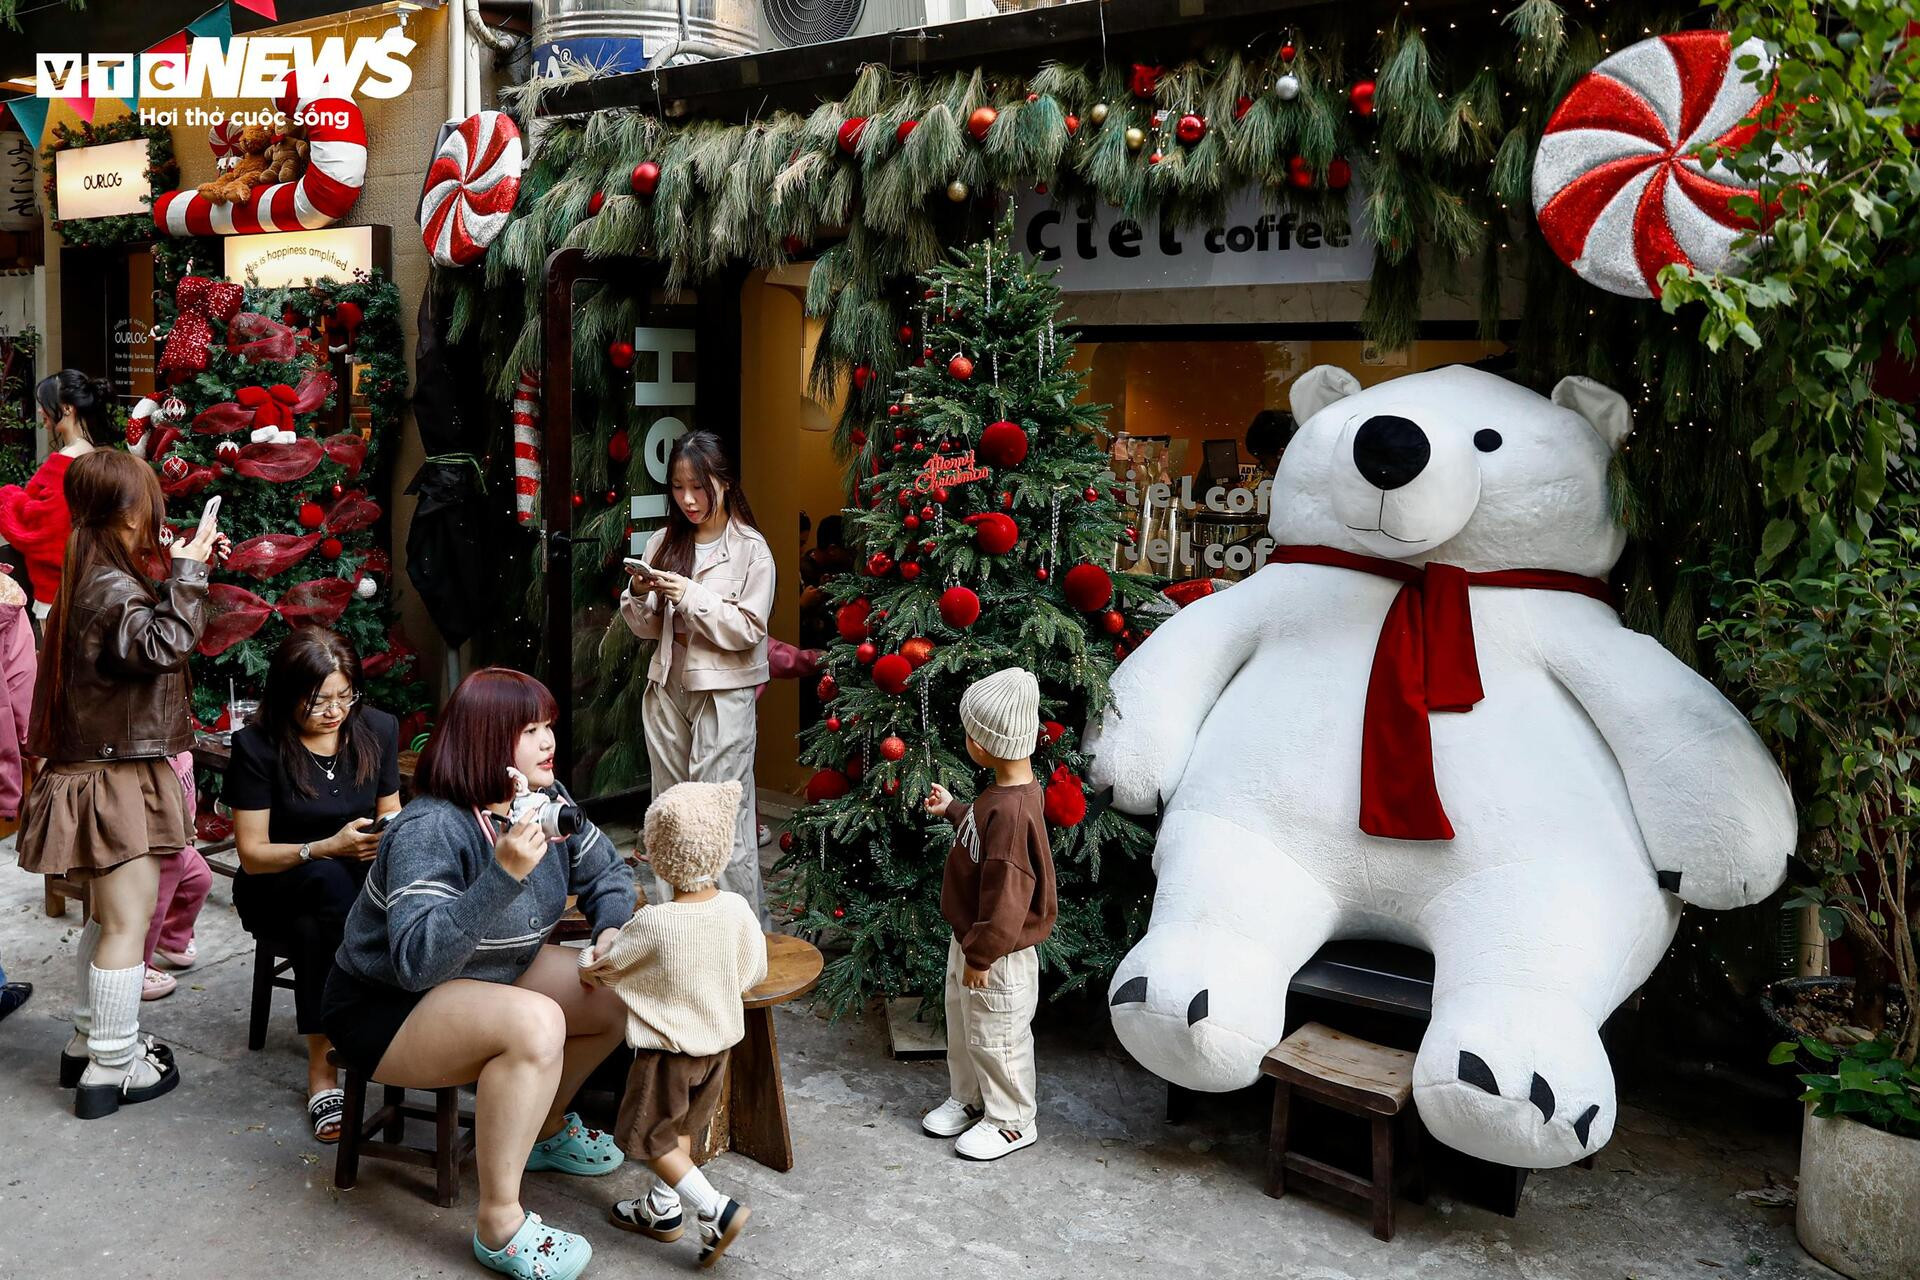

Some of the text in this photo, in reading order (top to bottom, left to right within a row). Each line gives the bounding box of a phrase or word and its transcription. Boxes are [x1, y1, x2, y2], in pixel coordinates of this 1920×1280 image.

[83, 171, 123, 191] OURLOG
[1204, 212, 1353, 254] coffee
[259, 255, 266, 266] is
[266, 245, 307, 261] happiness
[308, 247, 349, 272] amplified
[114, 331, 148, 344] OURLOG
[923, 449, 976, 472] Merry
